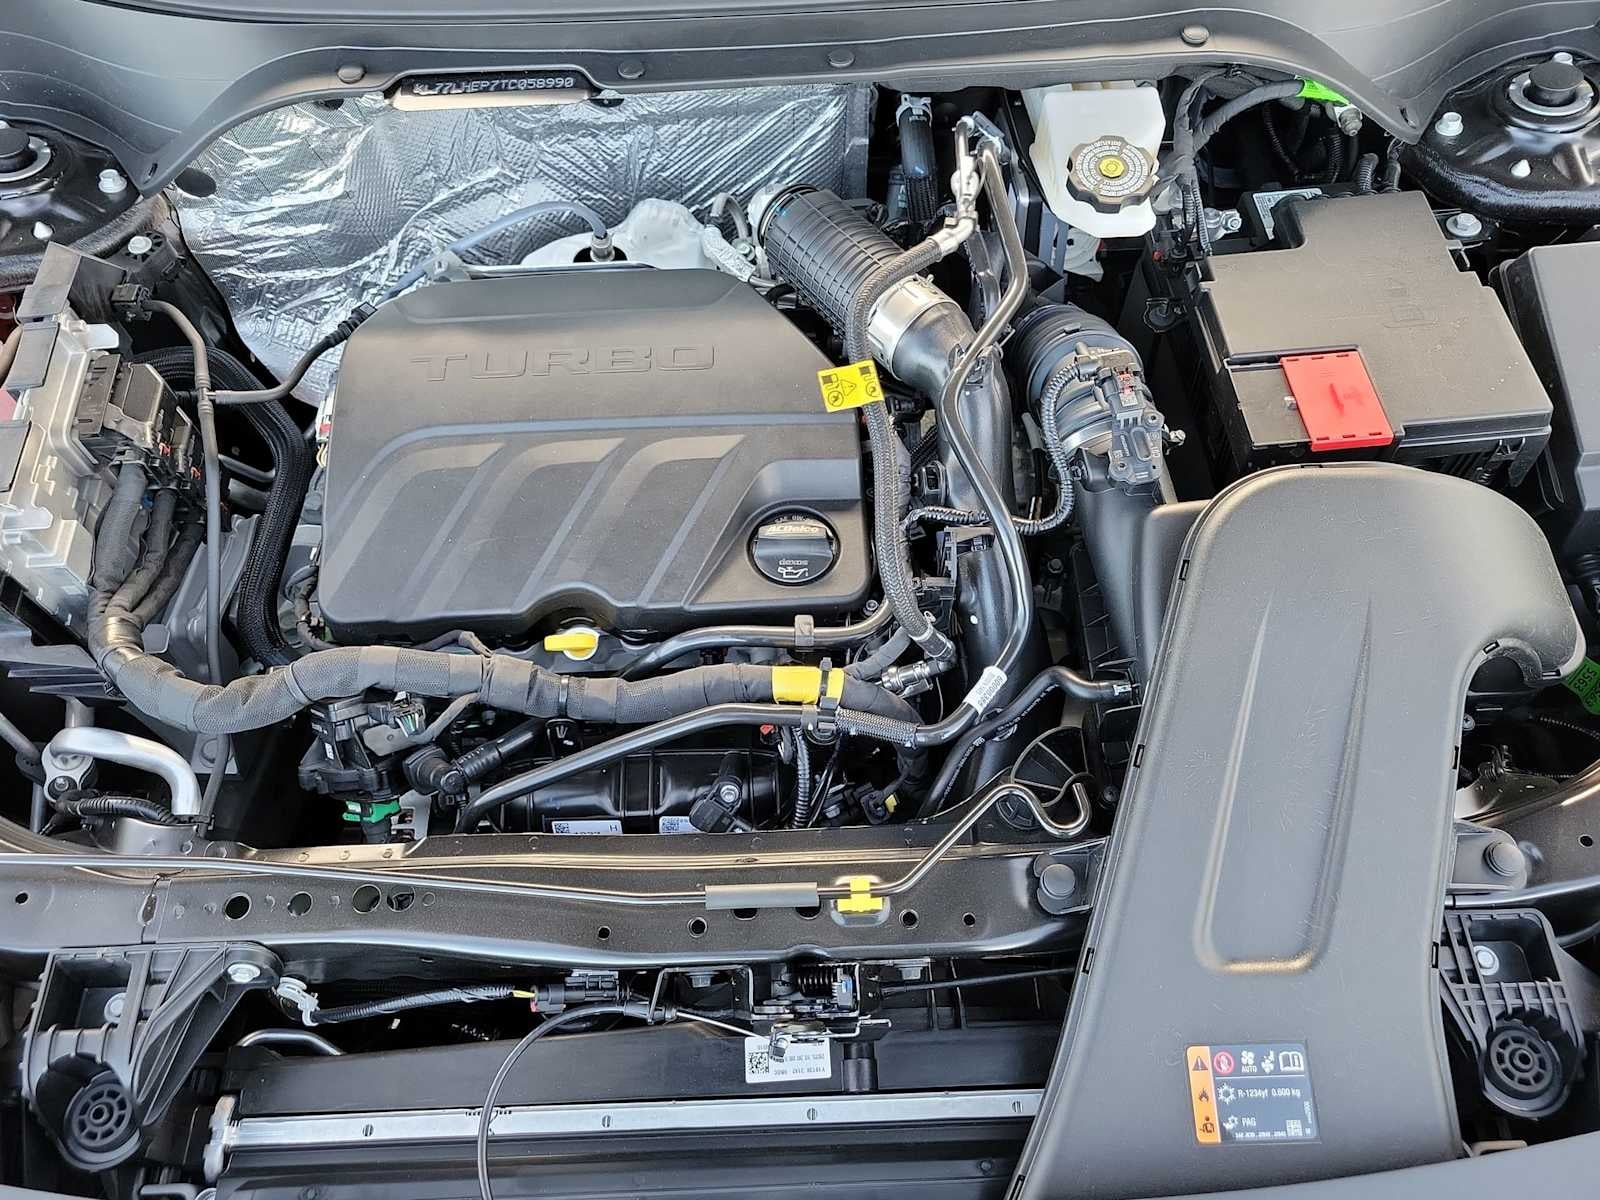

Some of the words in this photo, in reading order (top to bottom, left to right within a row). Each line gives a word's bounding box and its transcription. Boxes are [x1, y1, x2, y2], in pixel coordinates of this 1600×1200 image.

[410, 344, 716, 382] TURBO
[768, 526, 818, 534] ACDelco
[1241, 1065, 1258, 1073] AUTO
[1237, 1088, 1268, 1099] R-1234yf
[1291, 1088, 1301, 1098] kg
[1241, 1117, 1257, 1127] PAG
